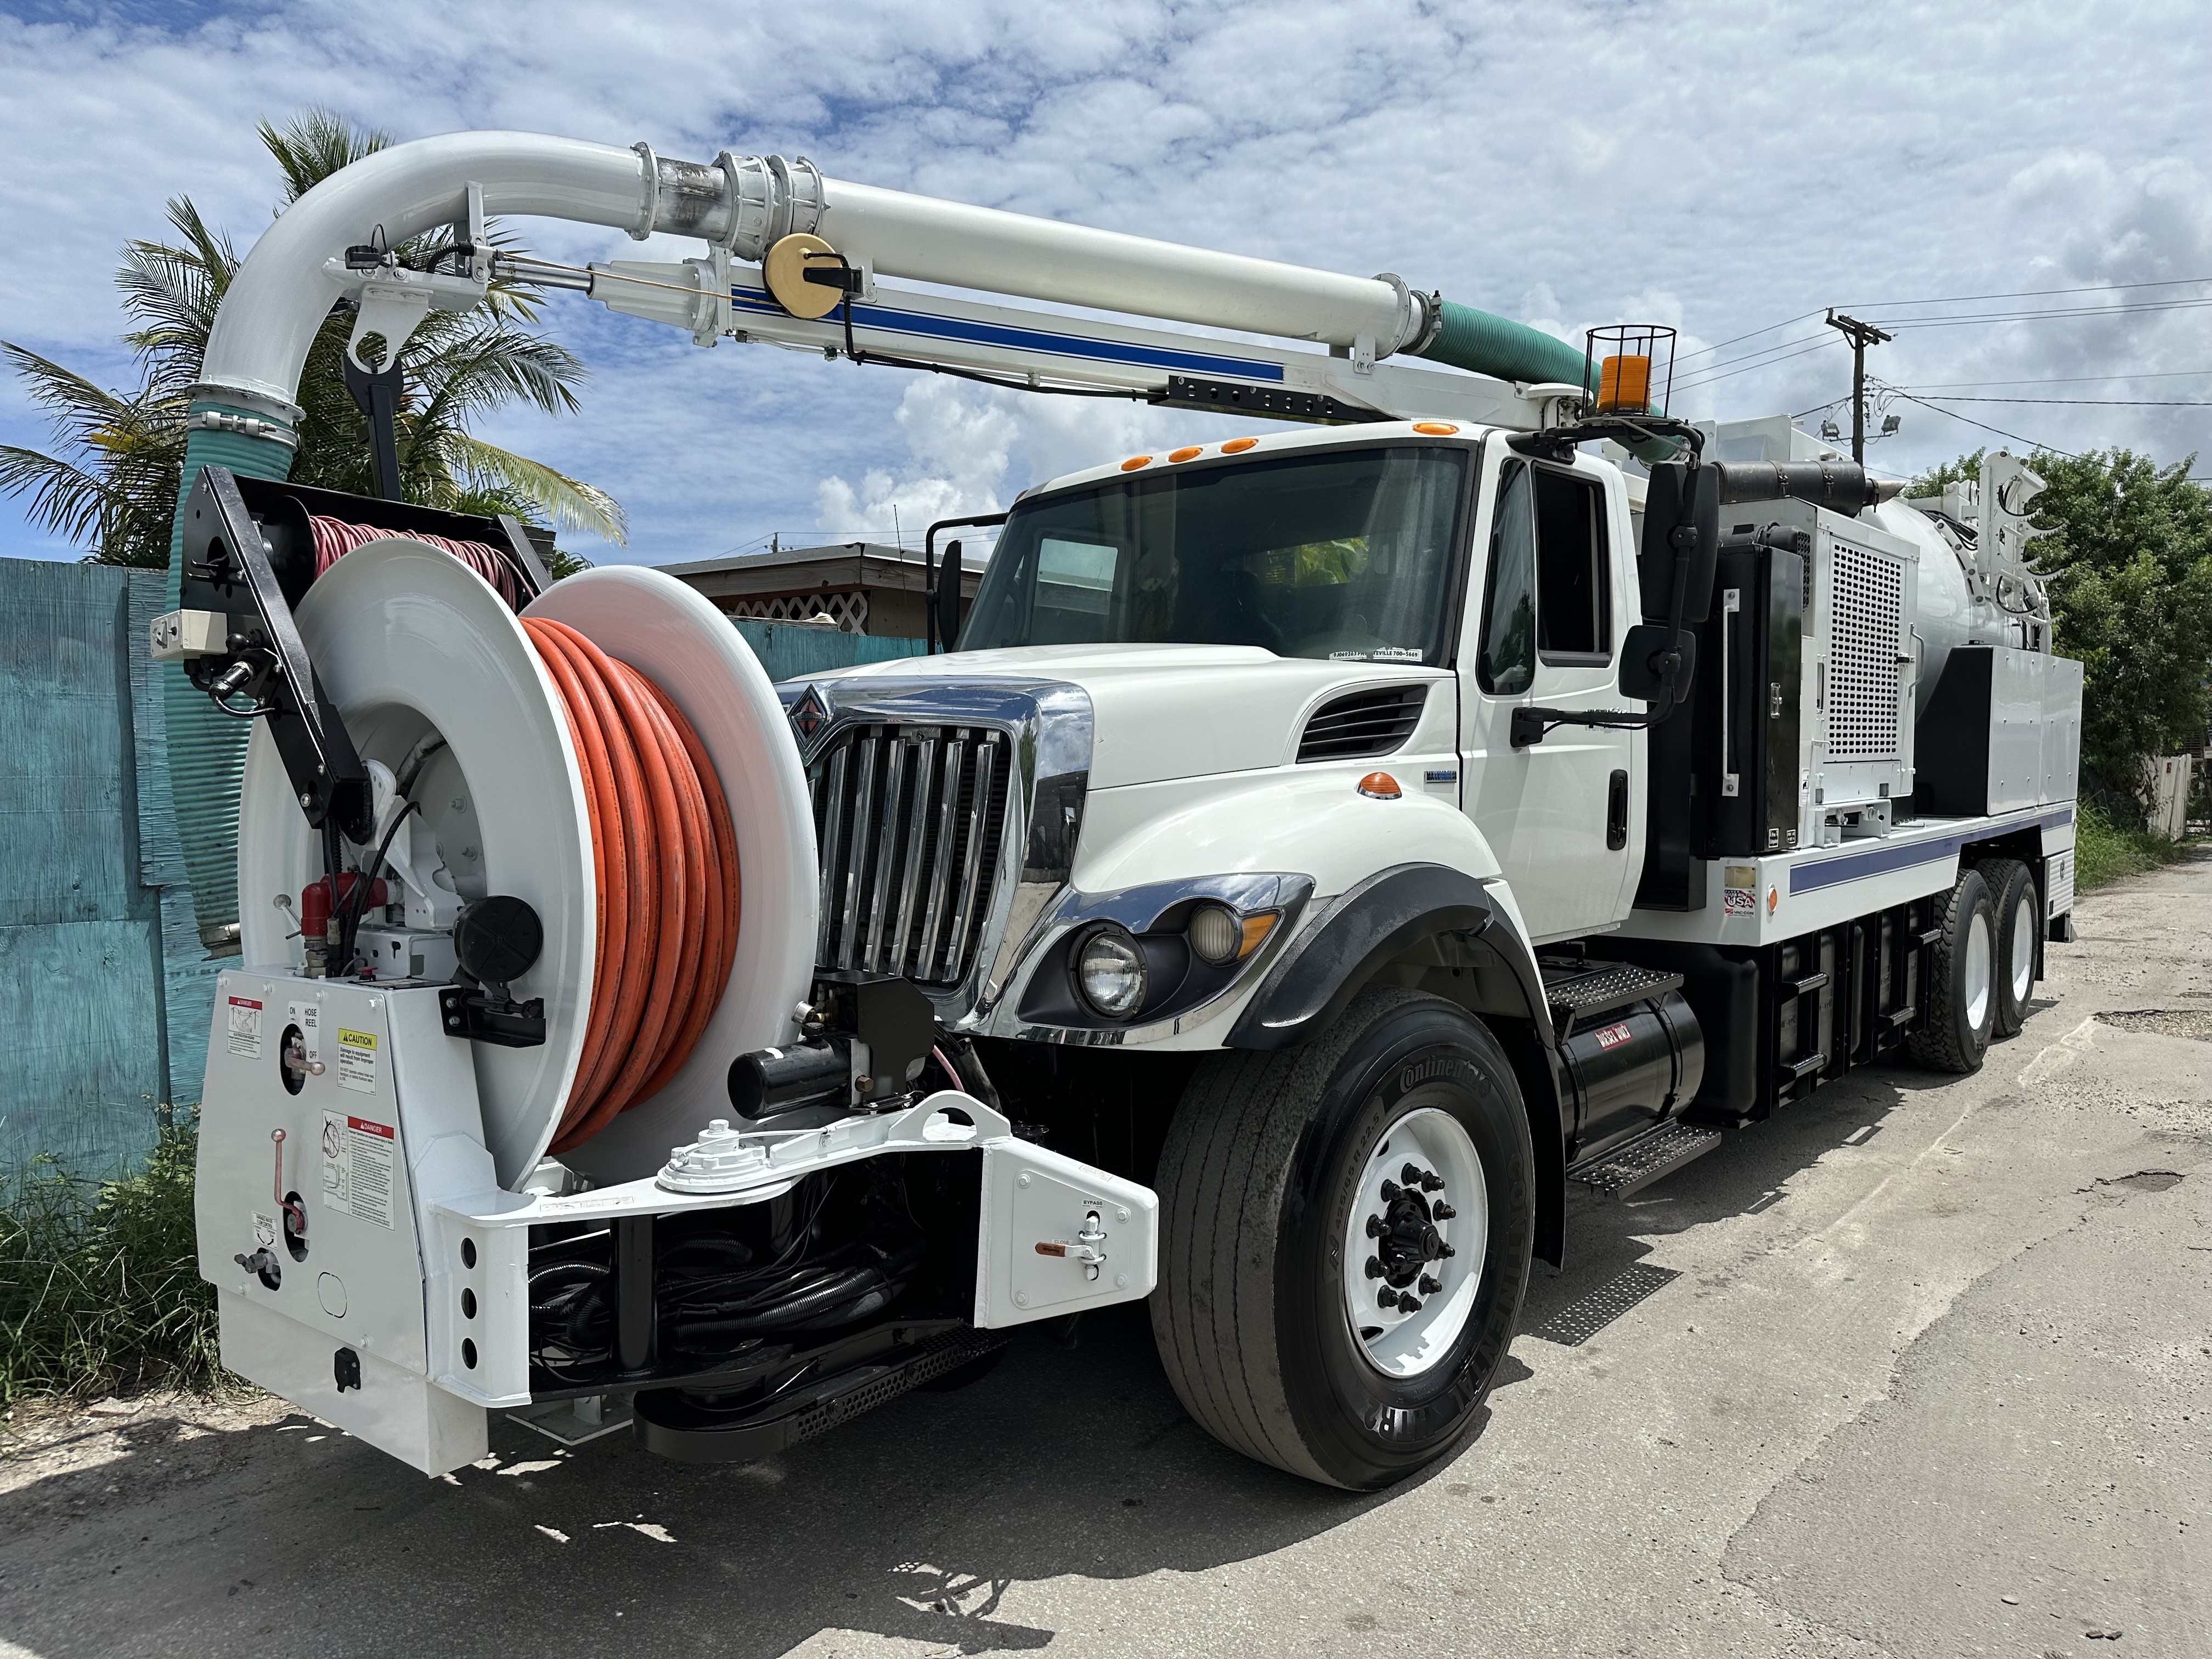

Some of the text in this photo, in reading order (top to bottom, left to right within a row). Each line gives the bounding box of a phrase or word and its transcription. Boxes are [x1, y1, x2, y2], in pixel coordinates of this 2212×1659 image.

[1727, 896, 1752, 906] USA
[304, 1008, 317, 1017] HOSE
[305, 1019, 317, 1027] REEL
[348, 1034, 372, 1046] CAUTION
[1596, 1025, 1631, 1047] DIESEL ONLY
[309, 1051, 317, 1059] OFF
[1400, 1053, 1482, 1093] Continental
[364, 1123, 382, 1133] DANGER
[1336, 1112, 1379, 1230] 425/65 R 22.5
[1448, 1154, 1527, 1413] CONTINENTAL
[1364, 1402, 1435, 1443] HTR2
